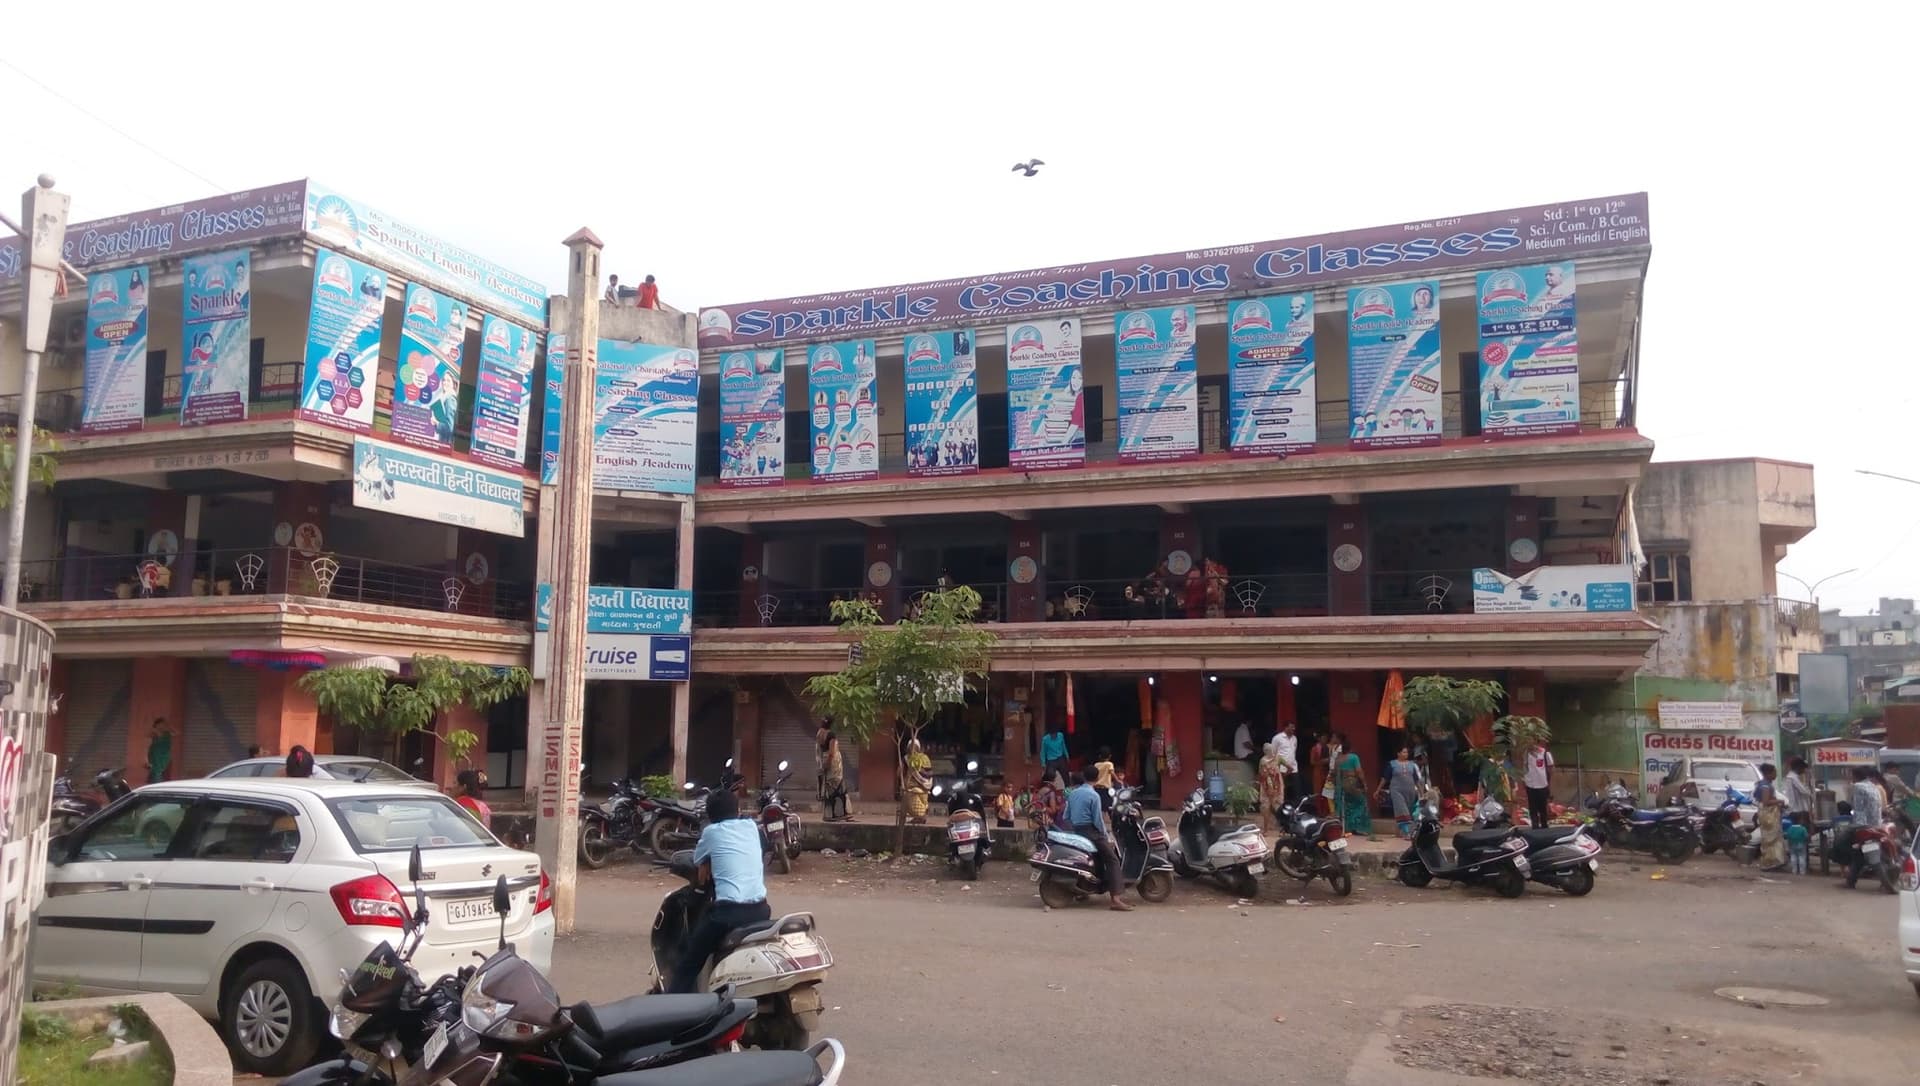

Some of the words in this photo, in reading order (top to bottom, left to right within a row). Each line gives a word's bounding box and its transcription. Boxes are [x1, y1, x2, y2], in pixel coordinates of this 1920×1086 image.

[1543, 208, 1562, 222] Std
[1573, 205, 1587, 217] 1st
[1589, 204, 1601, 216] to
[1604, 200, 1626, 214] 12th
[79, 217, 174, 265] Coaching
[180, 204, 265, 247] Classes
[1530, 224, 1550, 237] Sci.
[1559, 219, 1591, 234] Com.
[1599, 213, 1641, 228] B.Com.
[1525, 237, 1565, 251] Medium
[1573, 230, 1601, 245] Hindi
[1609, 226, 1647, 241] English
[368, 222, 426, 259] Sparkle
[431, 250, 482, 285] English
[1186, 252, 1201, 262] Mo.
[1054, 263, 1087, 275] Trust
[735, 292, 938, 339] Sparkle
[958, 263, 1232, 312] Coaching
[1253, 227, 1522, 278] Classes
[190, 288, 242, 312] Sparkle
[103, 330, 130, 340] OPEN
[1492, 324, 1504, 332] 1st
[1538, 319, 1560, 328] STD
[1247, 347, 1295, 355] ADMISSION
[598, 384, 650, 400] Coaching
[653, 389, 697, 402] Classes
[1411, 380, 1435, 392] OPEN
[596, 455, 637, 466] English
[641, 458, 694, 471] Academy
[384, 457, 441, 485] सरस्वती
[443, 465, 474, 494] हिन्दी
[475, 472, 521, 503] विद्यालय
[631, 591, 689, 610] વિદ્યાલય
[586, 646, 638, 665] ruise
[1645, 732, 1704, 750] નિલકંઠ
